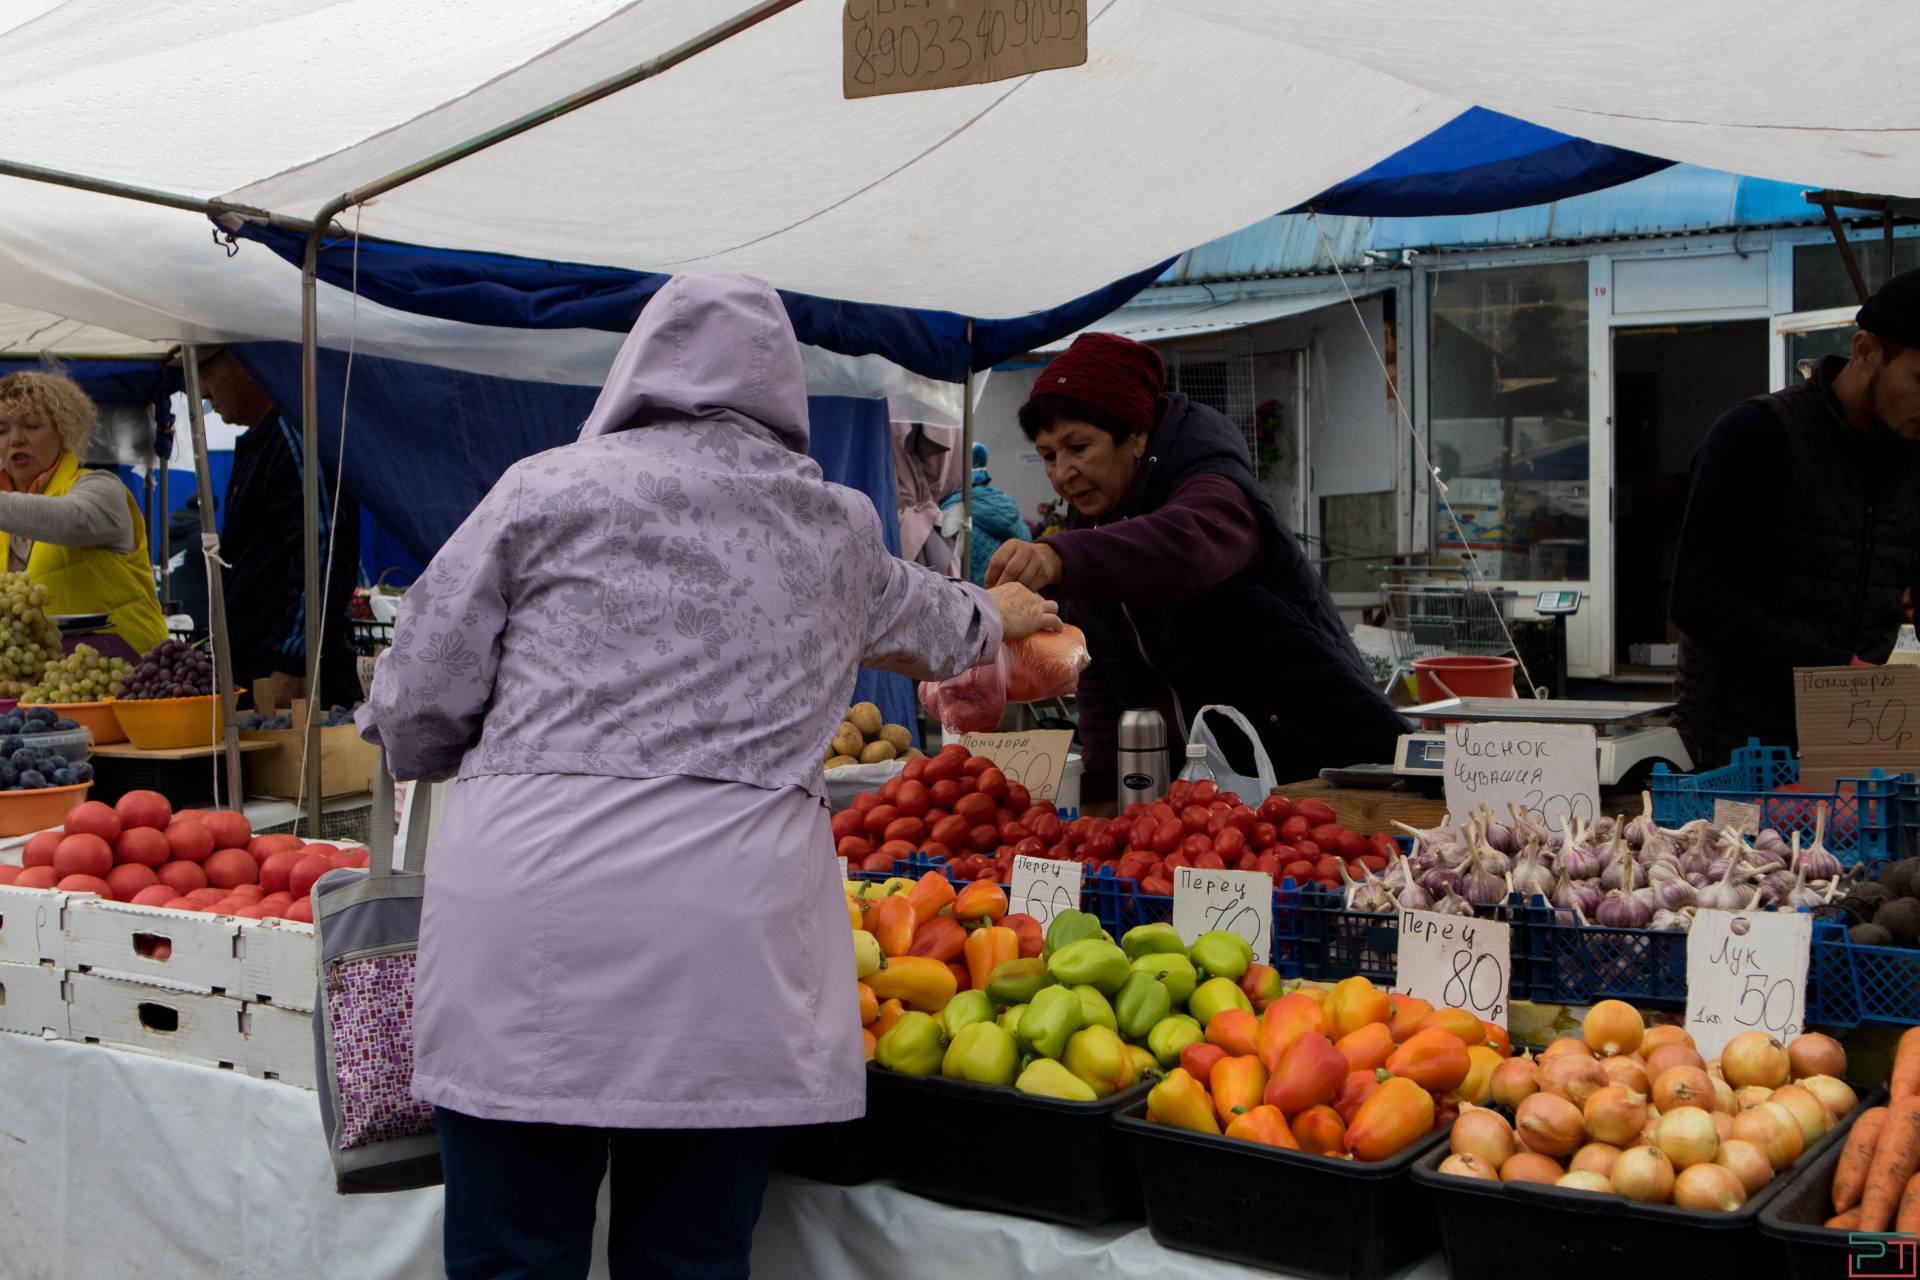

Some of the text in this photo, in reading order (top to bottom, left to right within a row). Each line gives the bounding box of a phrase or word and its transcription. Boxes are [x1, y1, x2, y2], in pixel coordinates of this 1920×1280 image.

[1455, 724, 1552, 759] Чеснок
[1018, 856, 1061, 878] Перец
[1181, 870, 1247, 900] Перец
[1402, 911, 1476, 950] Перец
[1710, 936, 1761, 976] Лук
